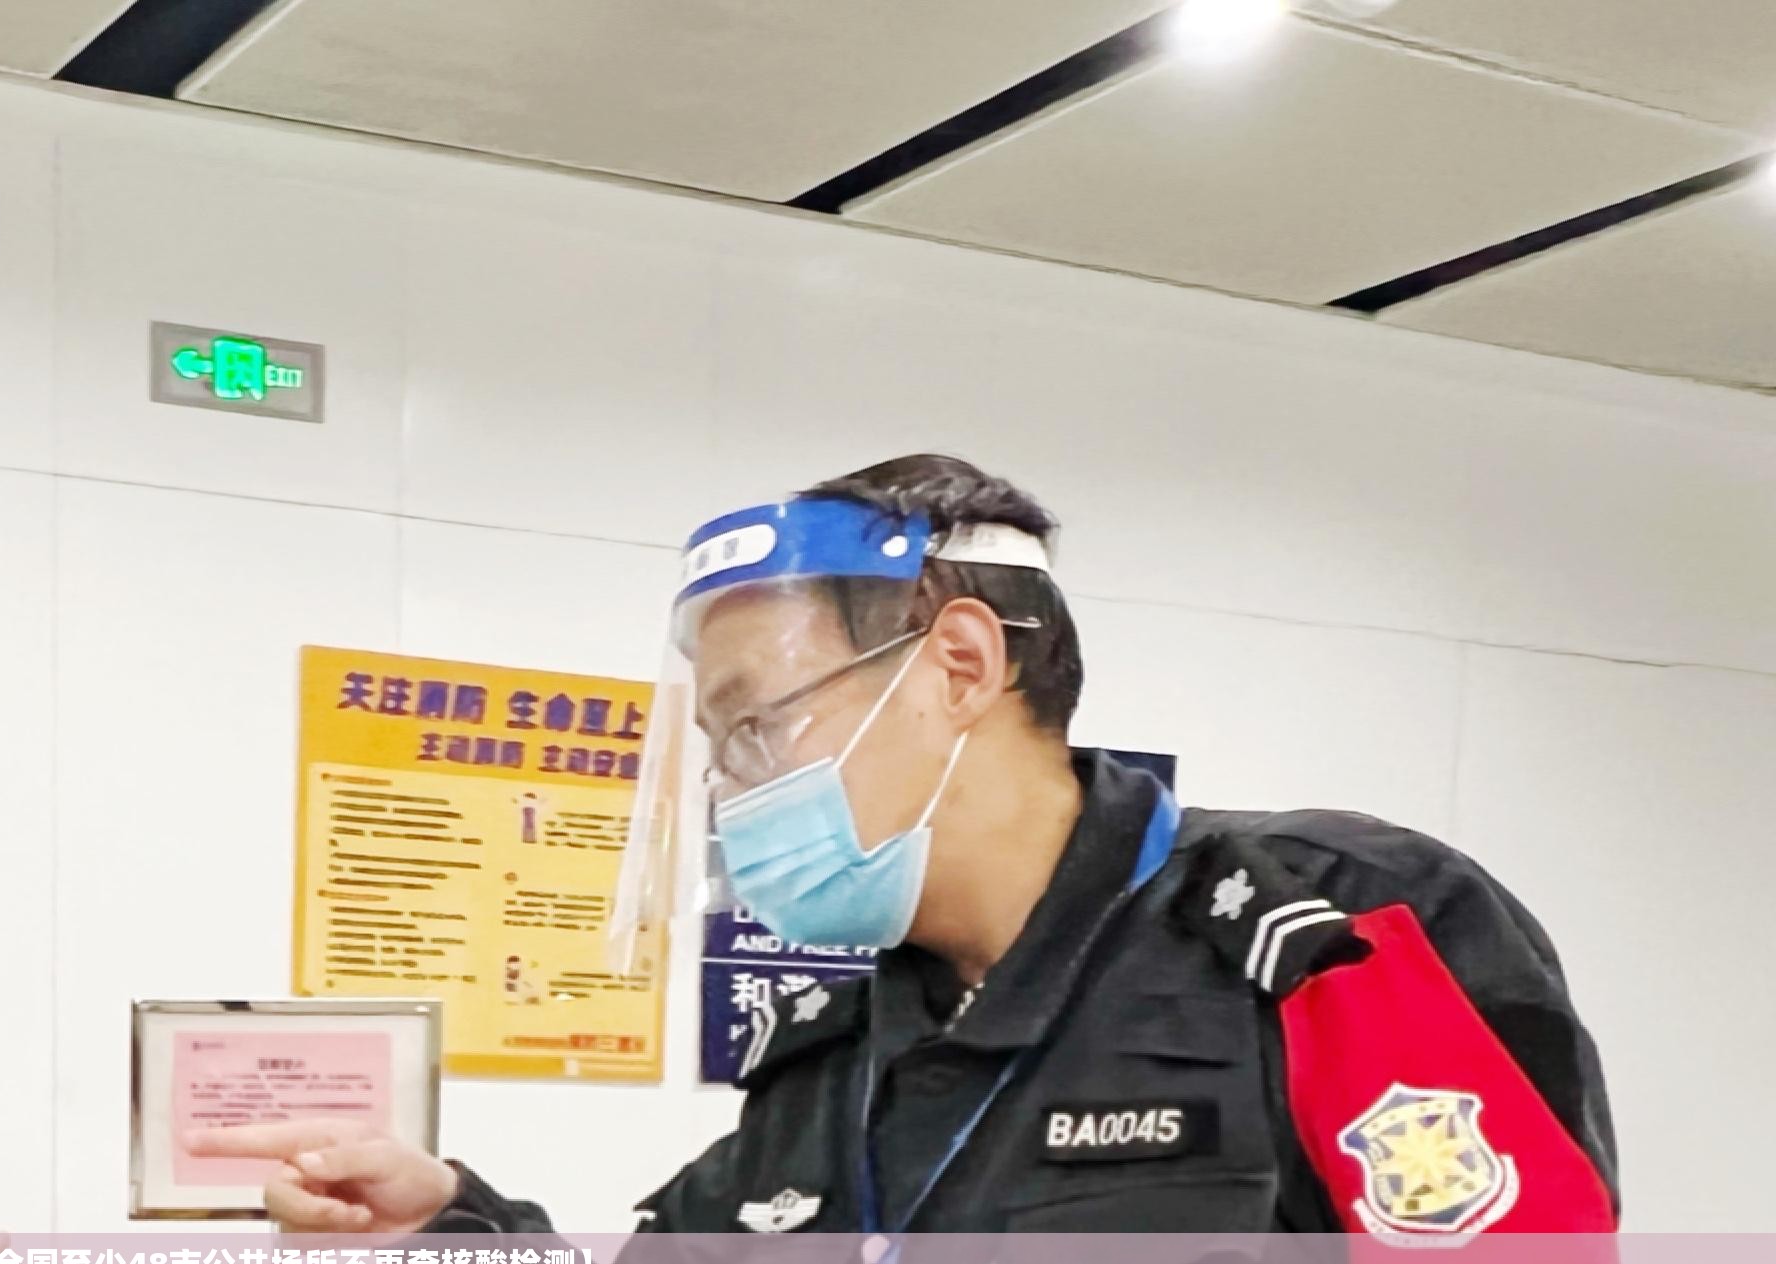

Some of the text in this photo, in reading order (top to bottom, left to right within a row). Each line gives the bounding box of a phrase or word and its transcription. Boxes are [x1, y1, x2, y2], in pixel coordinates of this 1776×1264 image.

[506, 691, 644, 740] 生命至上
[732, 934, 782, 952] AND
[1047, 1108, 1184, 1148] BA0045
